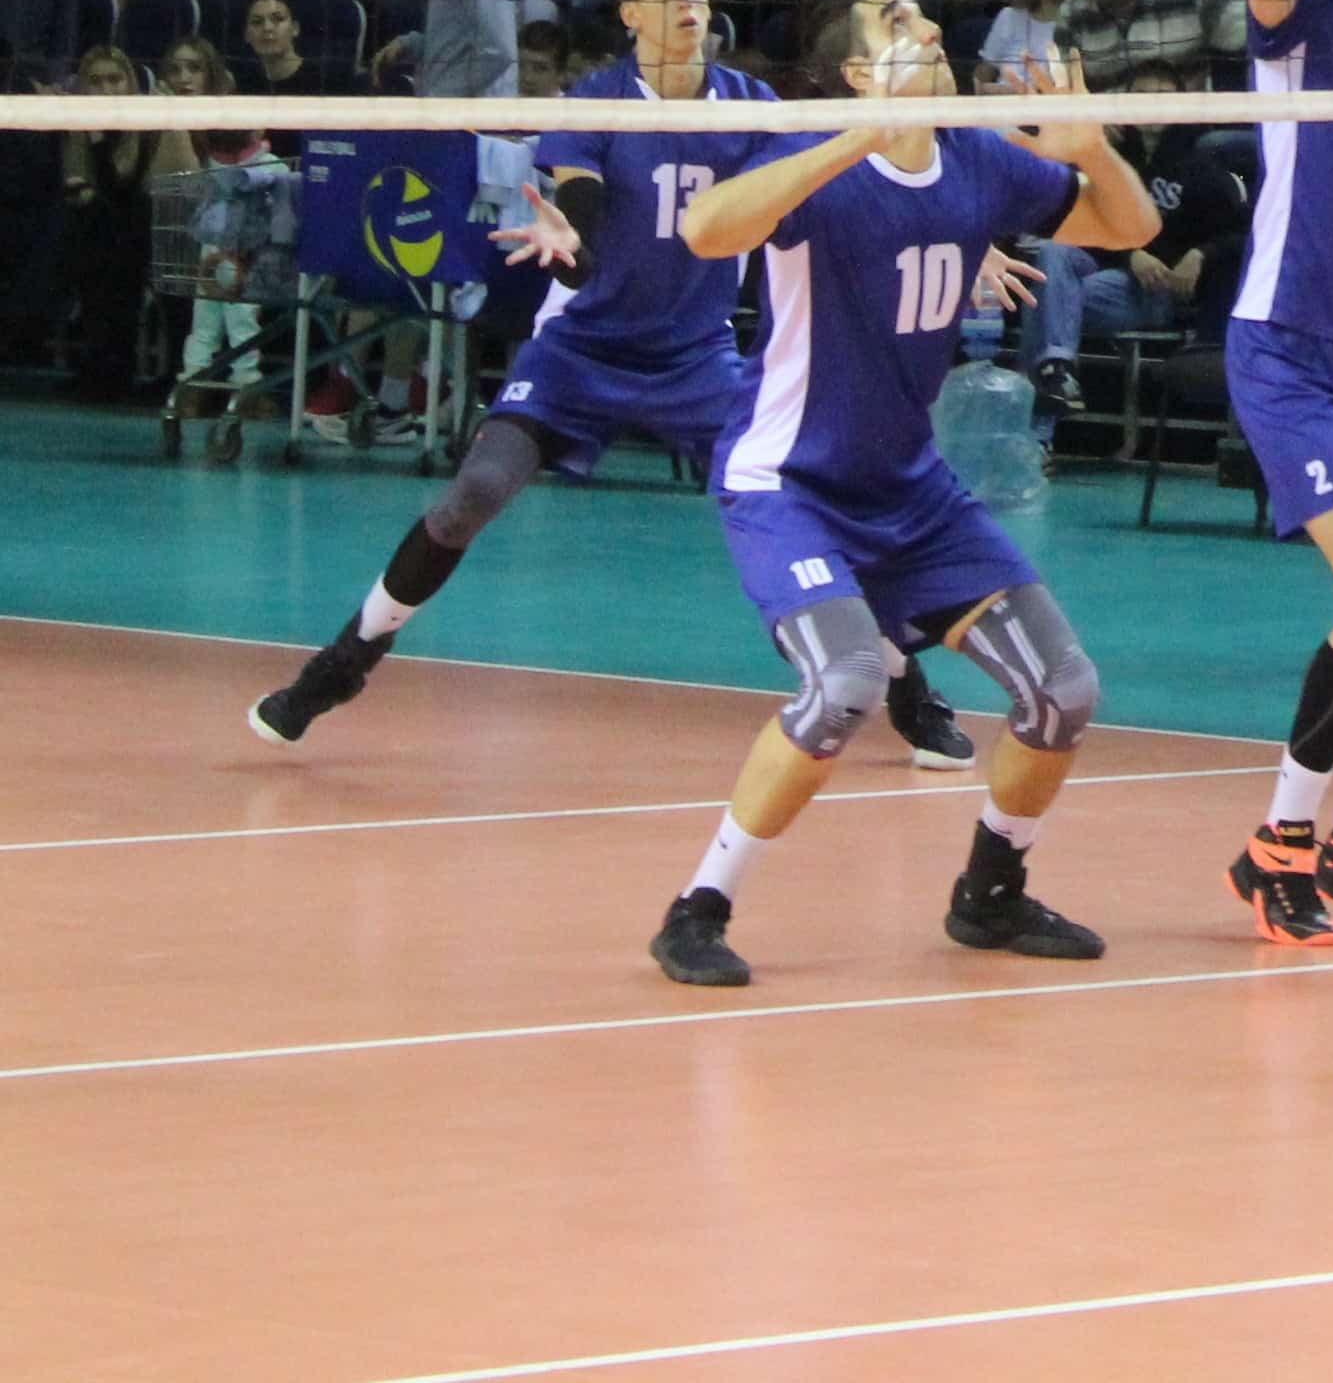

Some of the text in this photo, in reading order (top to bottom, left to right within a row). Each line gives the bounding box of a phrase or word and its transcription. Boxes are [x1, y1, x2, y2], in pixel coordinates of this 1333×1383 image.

[895, 242, 964, 335] 10
[502, 380, 534, 402] 13
[789, 557, 834, 591] 10
